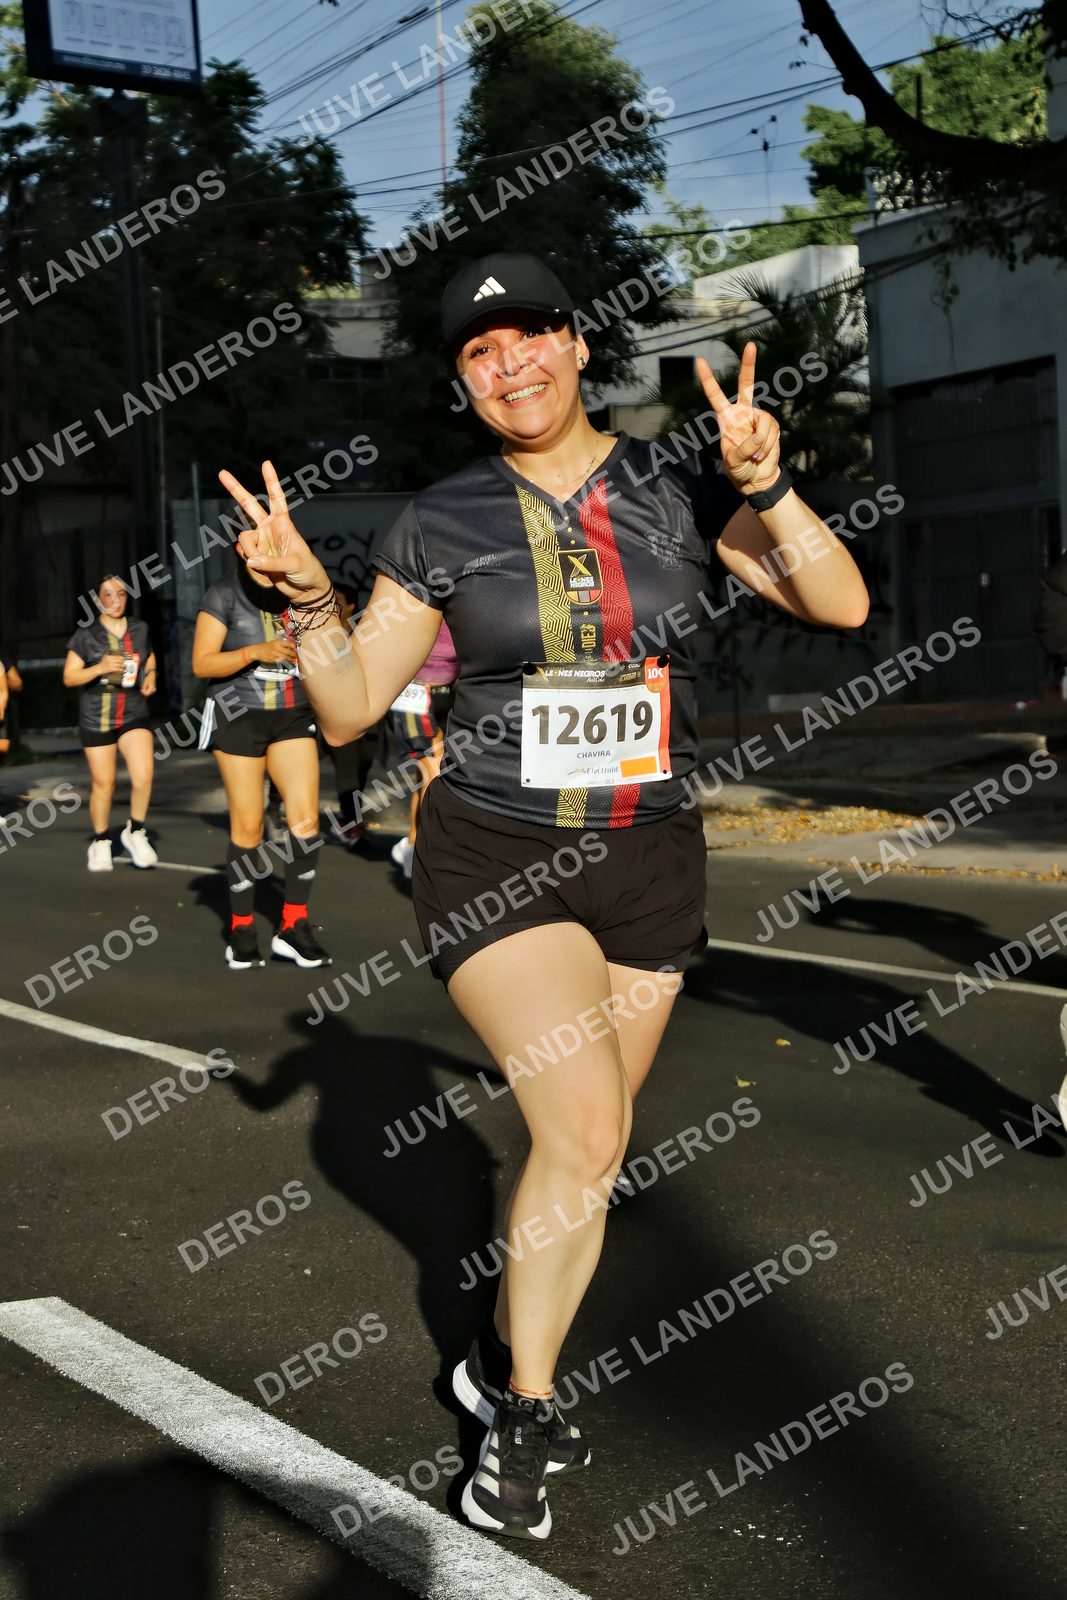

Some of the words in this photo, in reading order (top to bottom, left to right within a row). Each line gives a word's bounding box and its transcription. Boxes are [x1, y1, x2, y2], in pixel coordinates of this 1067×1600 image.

[573, 669, 606, 678] NEGROS
[531, 700, 654, 745] 12619
[576, 750, 611, 759] CHAVIRA
